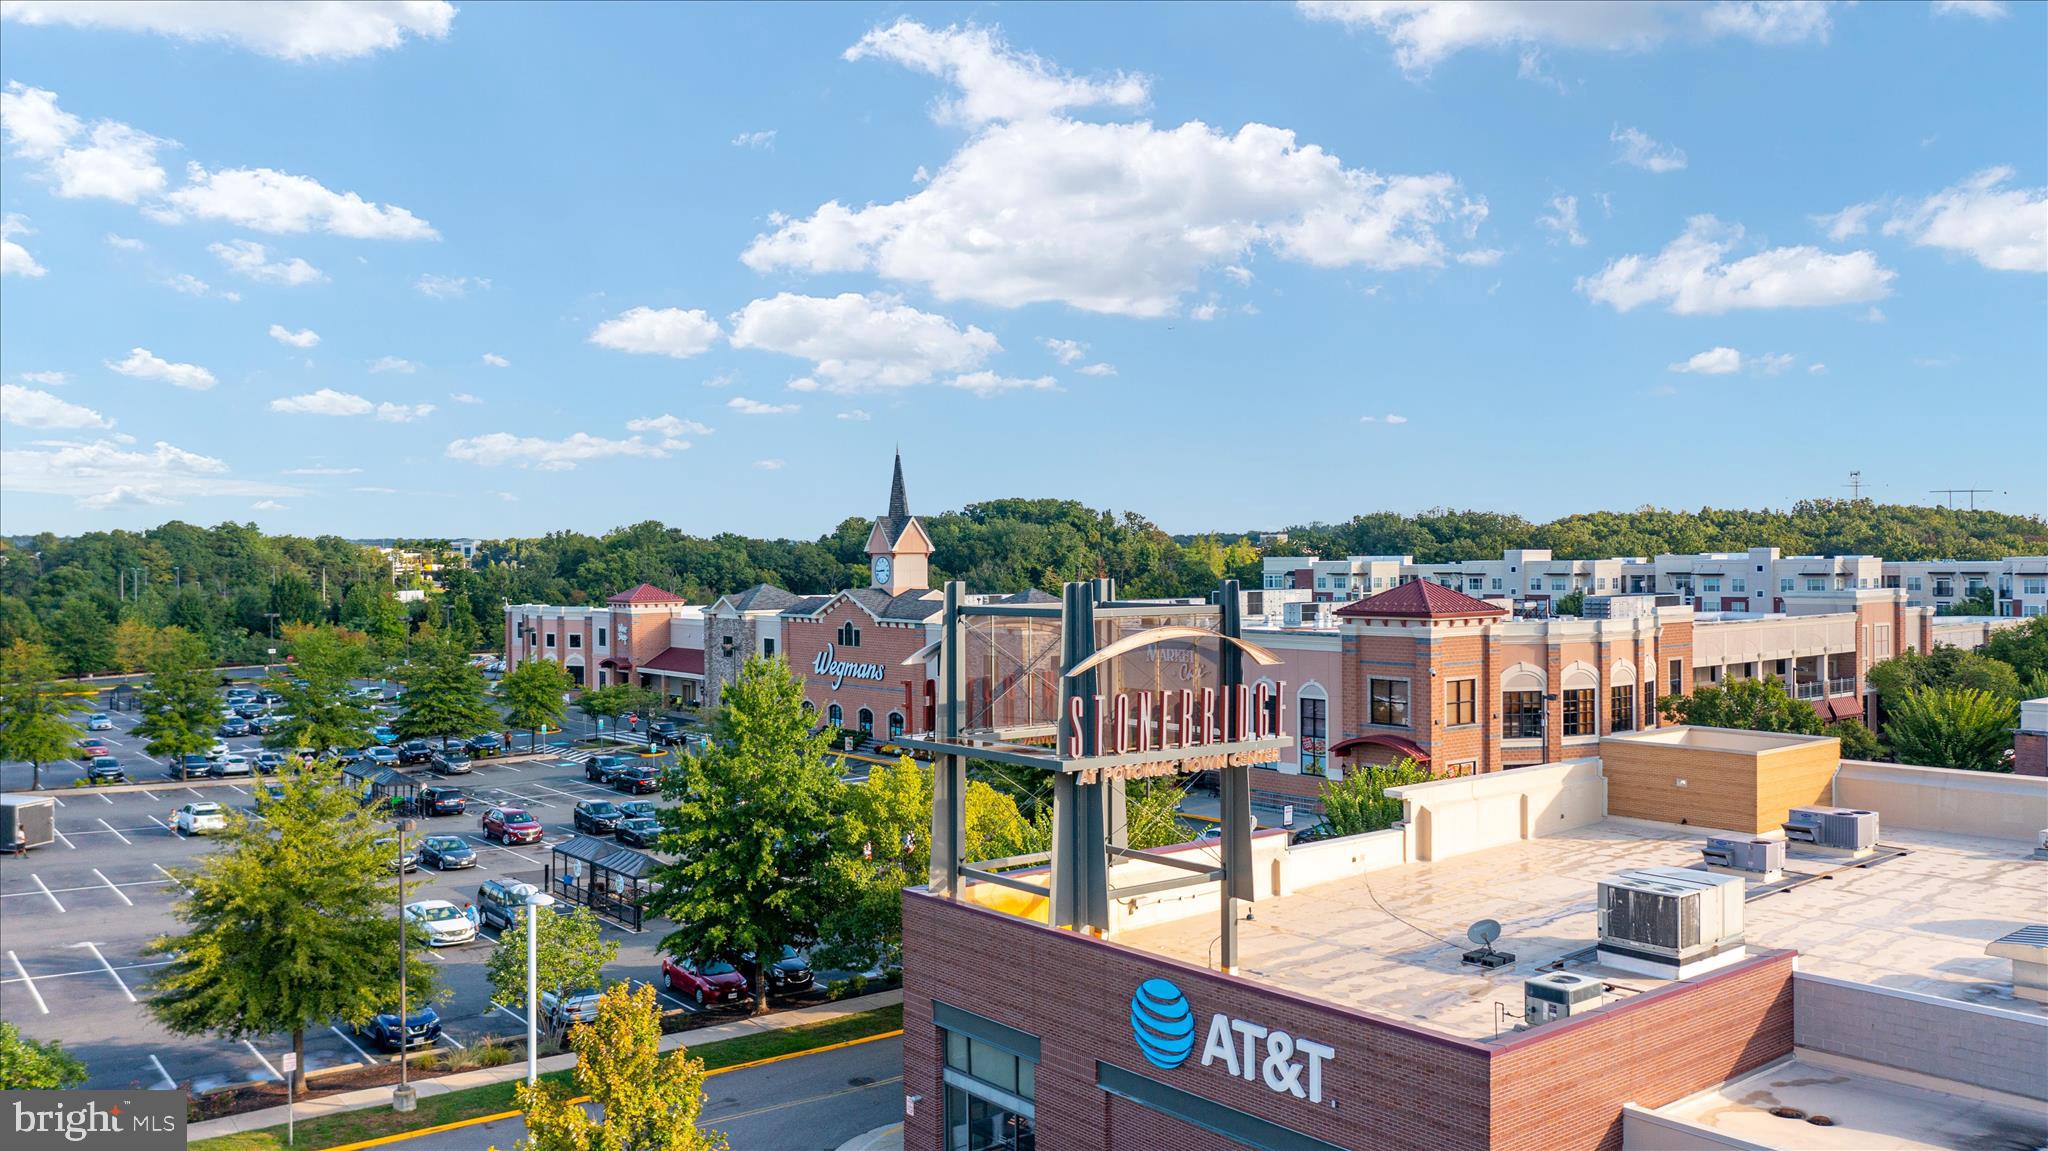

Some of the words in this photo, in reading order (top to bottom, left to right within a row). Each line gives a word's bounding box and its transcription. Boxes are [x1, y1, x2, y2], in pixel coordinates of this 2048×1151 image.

[812, 642, 884, 690] Wegmans
[1069, 681, 1288, 759] STONEBRIDGE
[1076, 767, 1098, 785] AT
[1103, 760, 1179, 783] POTOMAC
[1181, 752, 1227, 773] TOWN
[1229, 747, 1280, 768] CENTER
[1200, 1013, 1336, 1104] AT&T
